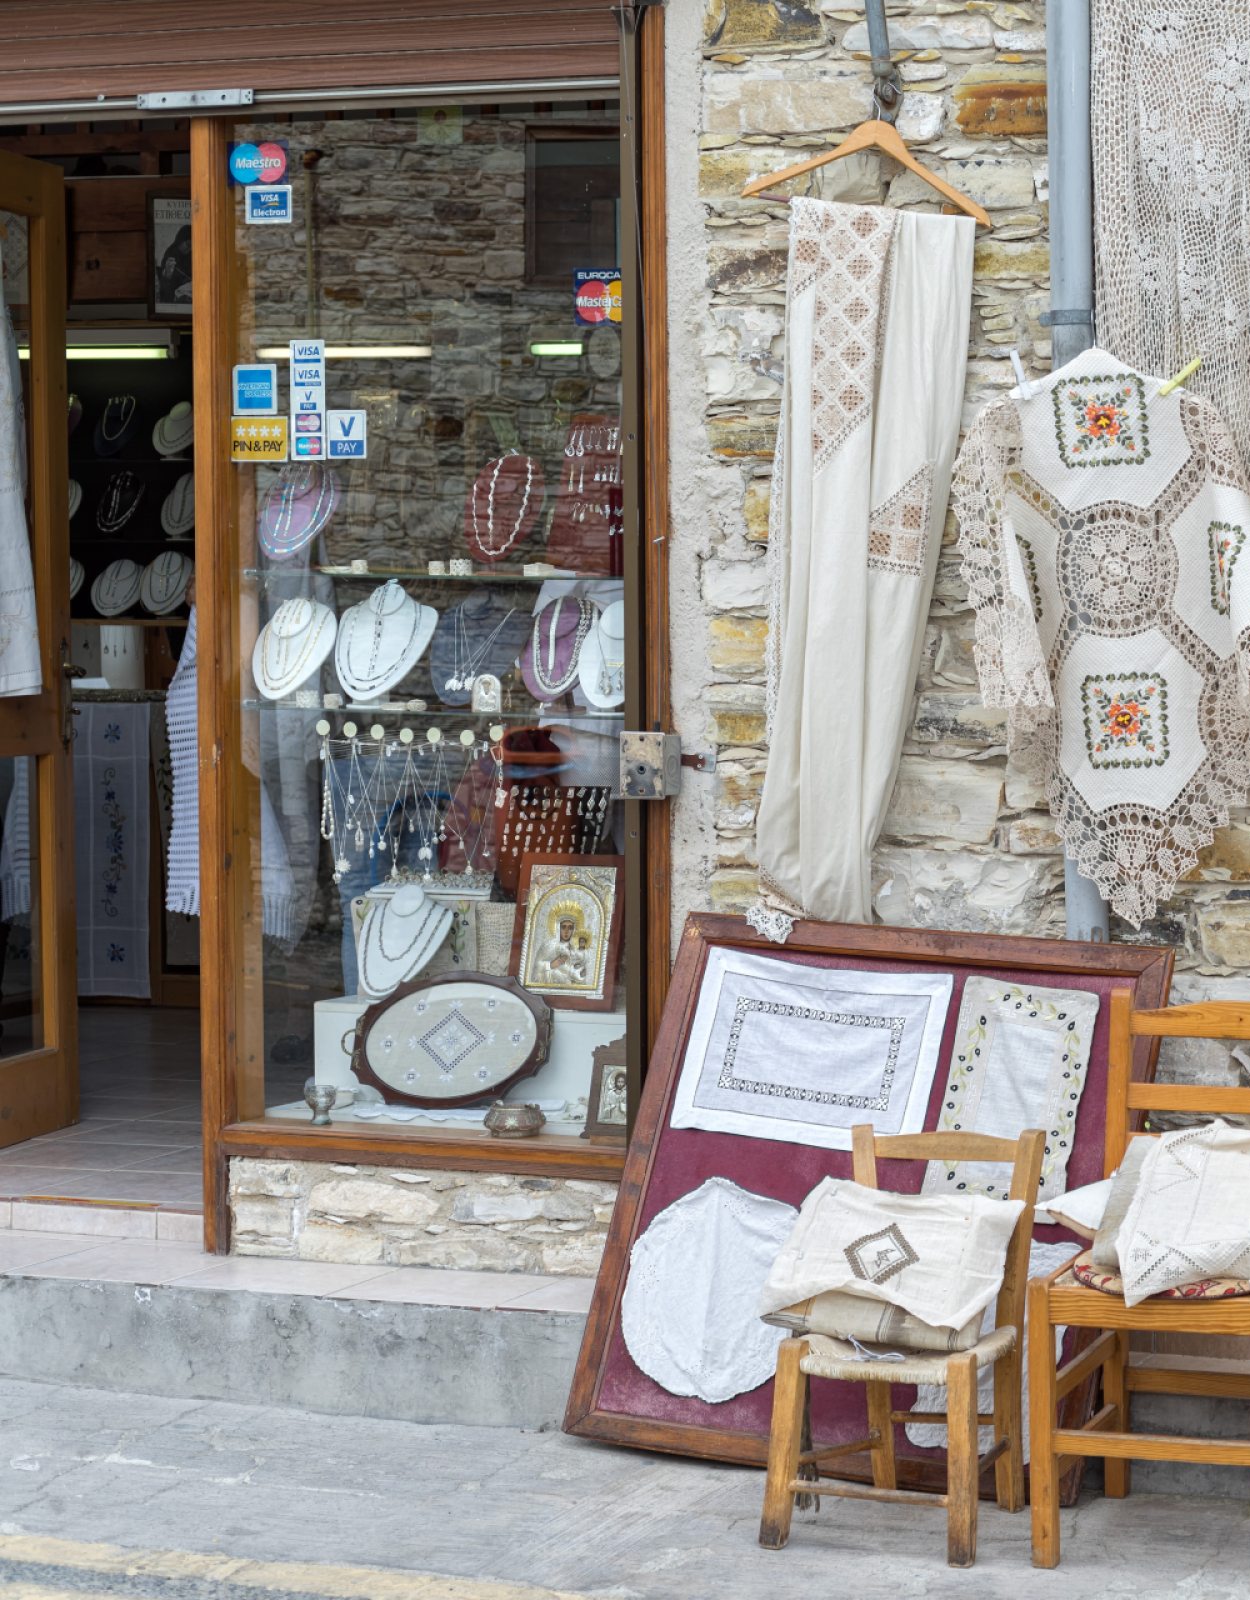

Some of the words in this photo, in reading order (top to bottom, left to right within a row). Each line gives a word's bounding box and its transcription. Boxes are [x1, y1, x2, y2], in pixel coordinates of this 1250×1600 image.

[235, 157, 281, 169] Maestro
[260, 194, 279, 202] VISA
[253, 208, 286, 216] Electron
[297, 346, 320, 356] VISA
[297, 369, 320, 380] VISA
[336, 416, 356, 437] V
[337, 442, 357, 453] PAY
